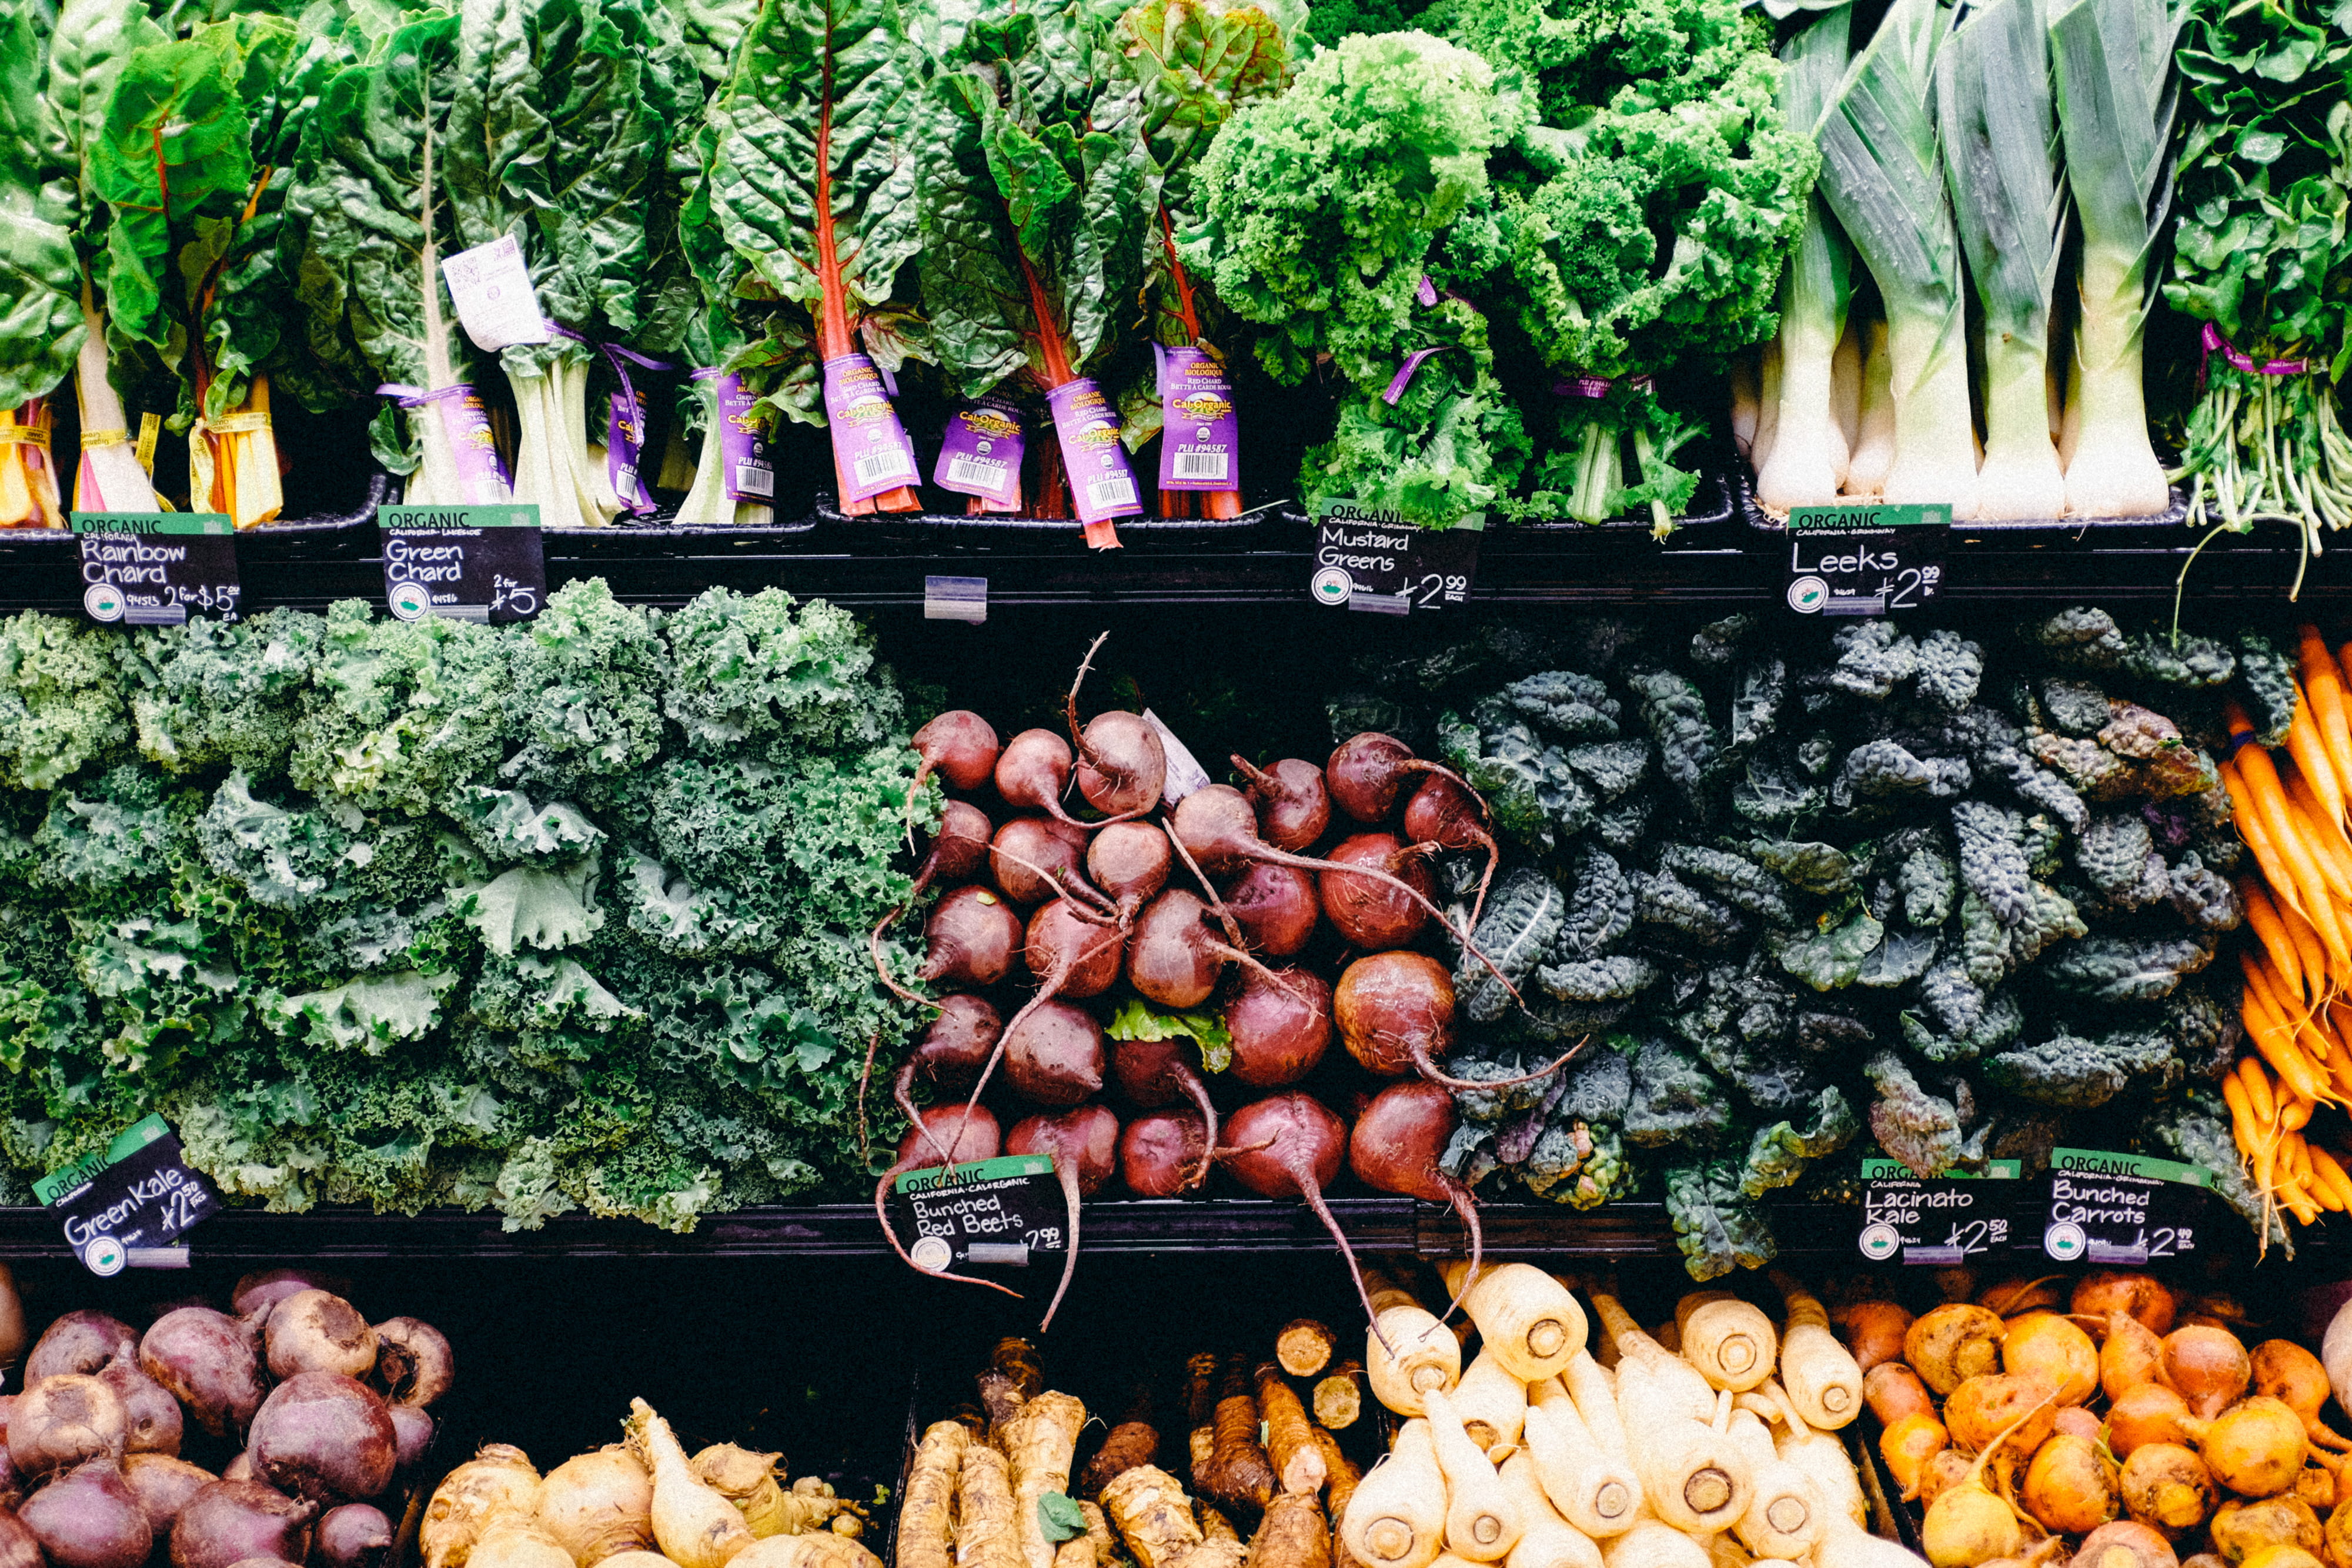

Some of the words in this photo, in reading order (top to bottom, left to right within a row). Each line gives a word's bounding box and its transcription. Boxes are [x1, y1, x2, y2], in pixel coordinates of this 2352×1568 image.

[843, 366, 873, 377] ORGANIC
[855, 448, 870, 460] PLU
[1178, 444, 1194, 452] PLU
[1195, 444, 1228, 453] #94587
[739, 456, 753, 466] PLU
[955, 452, 973, 462] PLU
[973, 454, 1008, 468] #94587
[1087, 473, 1103, 484] PLU
[389, 512, 470, 528] ORGANIC
[1329, 517, 1377, 527] CALIFORNIA
[1331, 504, 1404, 523] ORGANI
[1798, 512, 1881, 528] ORGANIC
[81, 519, 162, 534] ORGANIC
[83, 532, 137, 541] CALIFORNIA
[1322, 526, 1409, 551] Mustard
[81, 539, 186, 563] Rainbow
[386, 539, 464, 561] Green
[1318, 546, 1395, 571] Greens
[1792, 542, 1899, 573] Leeks
[83, 561, 167, 584] Chard
[387, 561, 462, 582] Chard
[2057, 1170, 2113, 1180] CALIFORNIA
[2061, 1155, 2142, 1176] ORGANIC
[46, 1154, 115, 1200] ORGANIC
[906, 1168, 988, 1192] ORGANIC
[909, 1186, 965, 1201] CALIFORNIA
[1865, 1188, 1974, 1208] Lacinato
[2052, 1178, 2150, 1206] Bunched
[64, 1198, 138, 1246] Green
[128, 1168, 182, 1205] Kale
[913, 1194, 1001, 1219] Bunched
[1866, 1208, 1921, 1225] Kale
[2052, 1201, 2146, 1224] Carrots
[916, 1218, 956, 1238] Red
[961, 1211, 1024, 1234] Beets
